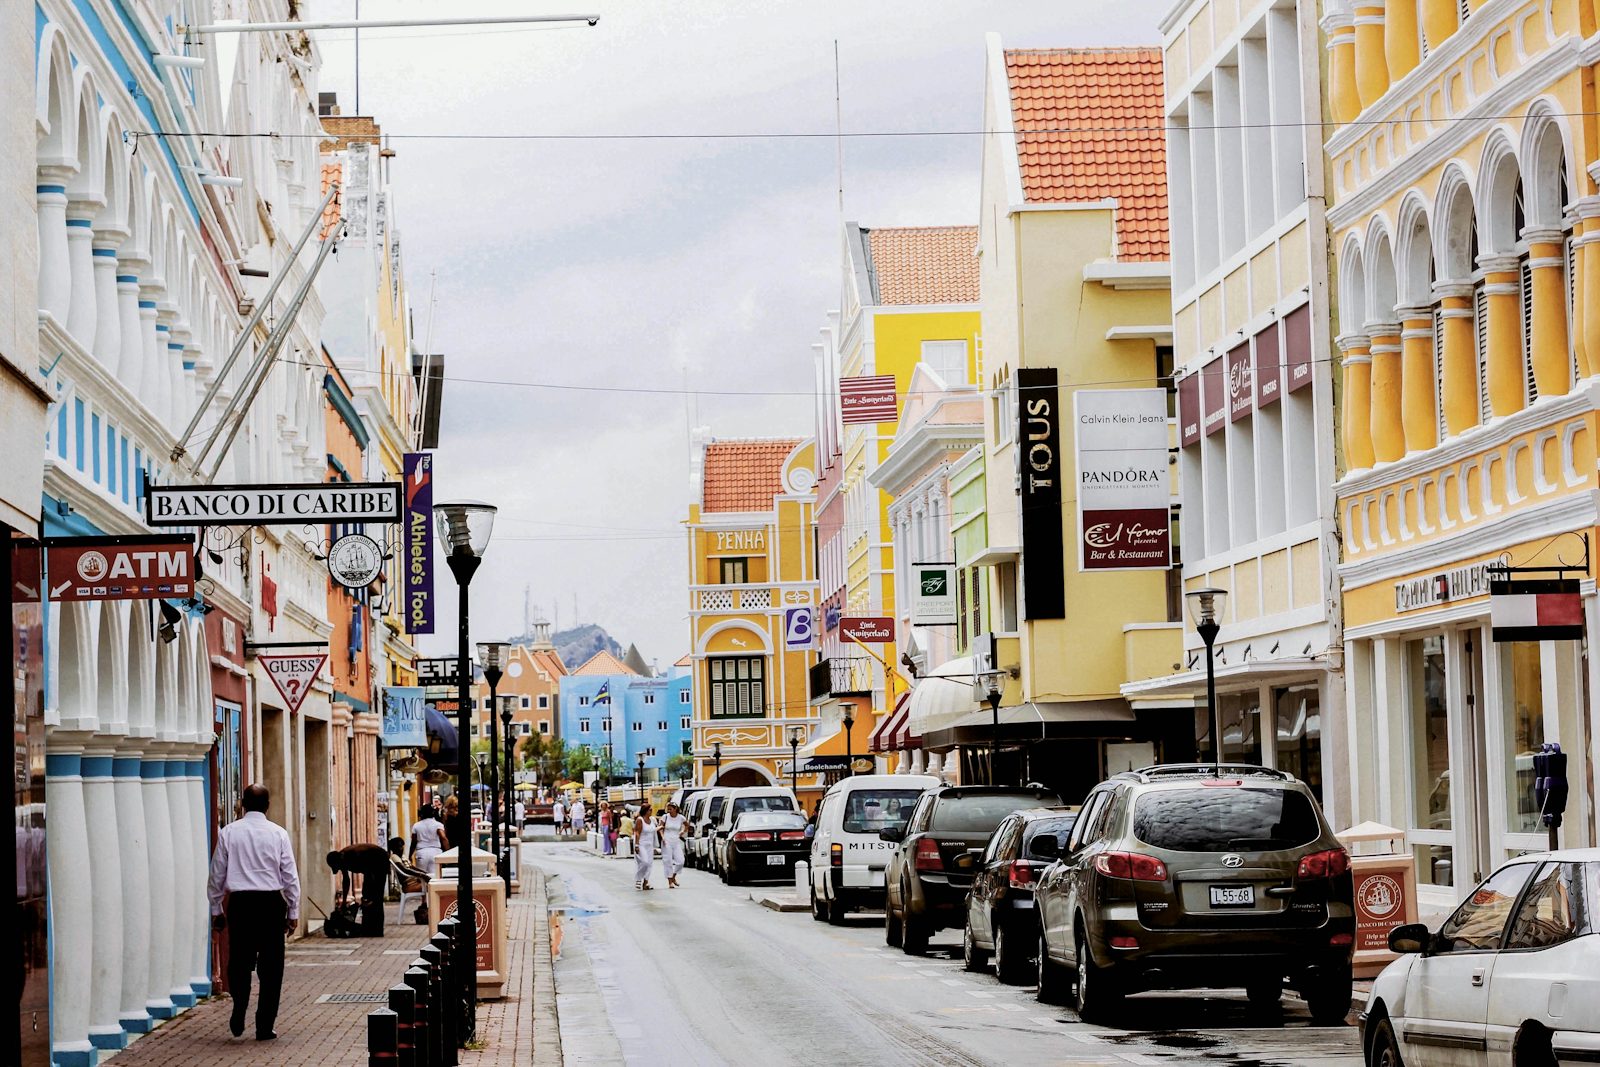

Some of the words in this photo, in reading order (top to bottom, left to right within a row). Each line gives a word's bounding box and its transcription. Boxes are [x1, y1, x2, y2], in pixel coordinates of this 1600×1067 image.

[1081, 414, 1110, 424] Calvin
[1112, 413, 1135, 423] Klein
[1138, 413, 1164, 424] Jeans
[1027, 399, 1052, 494] TOUS
[422, 455, 430, 469] The
[1082, 468, 1159, 483] PANDORA
[156, 494, 250, 516] BANCO
[257, 493, 285, 515] DI
[293, 492, 394, 514] CARIBE
[411, 511, 427, 585] Athlete's
[716, 530, 765, 550] PENHA
[1133, 537, 1158, 546] pizzeria
[1090, 550, 1107, 560] Bar
[1107, 550, 1116, 559] &
[1118, 550, 1164, 559] Restaurant
[109, 551, 187, 579] ATM
[411, 591, 428, 626] Foot
[269, 660, 315, 673] GUESS
